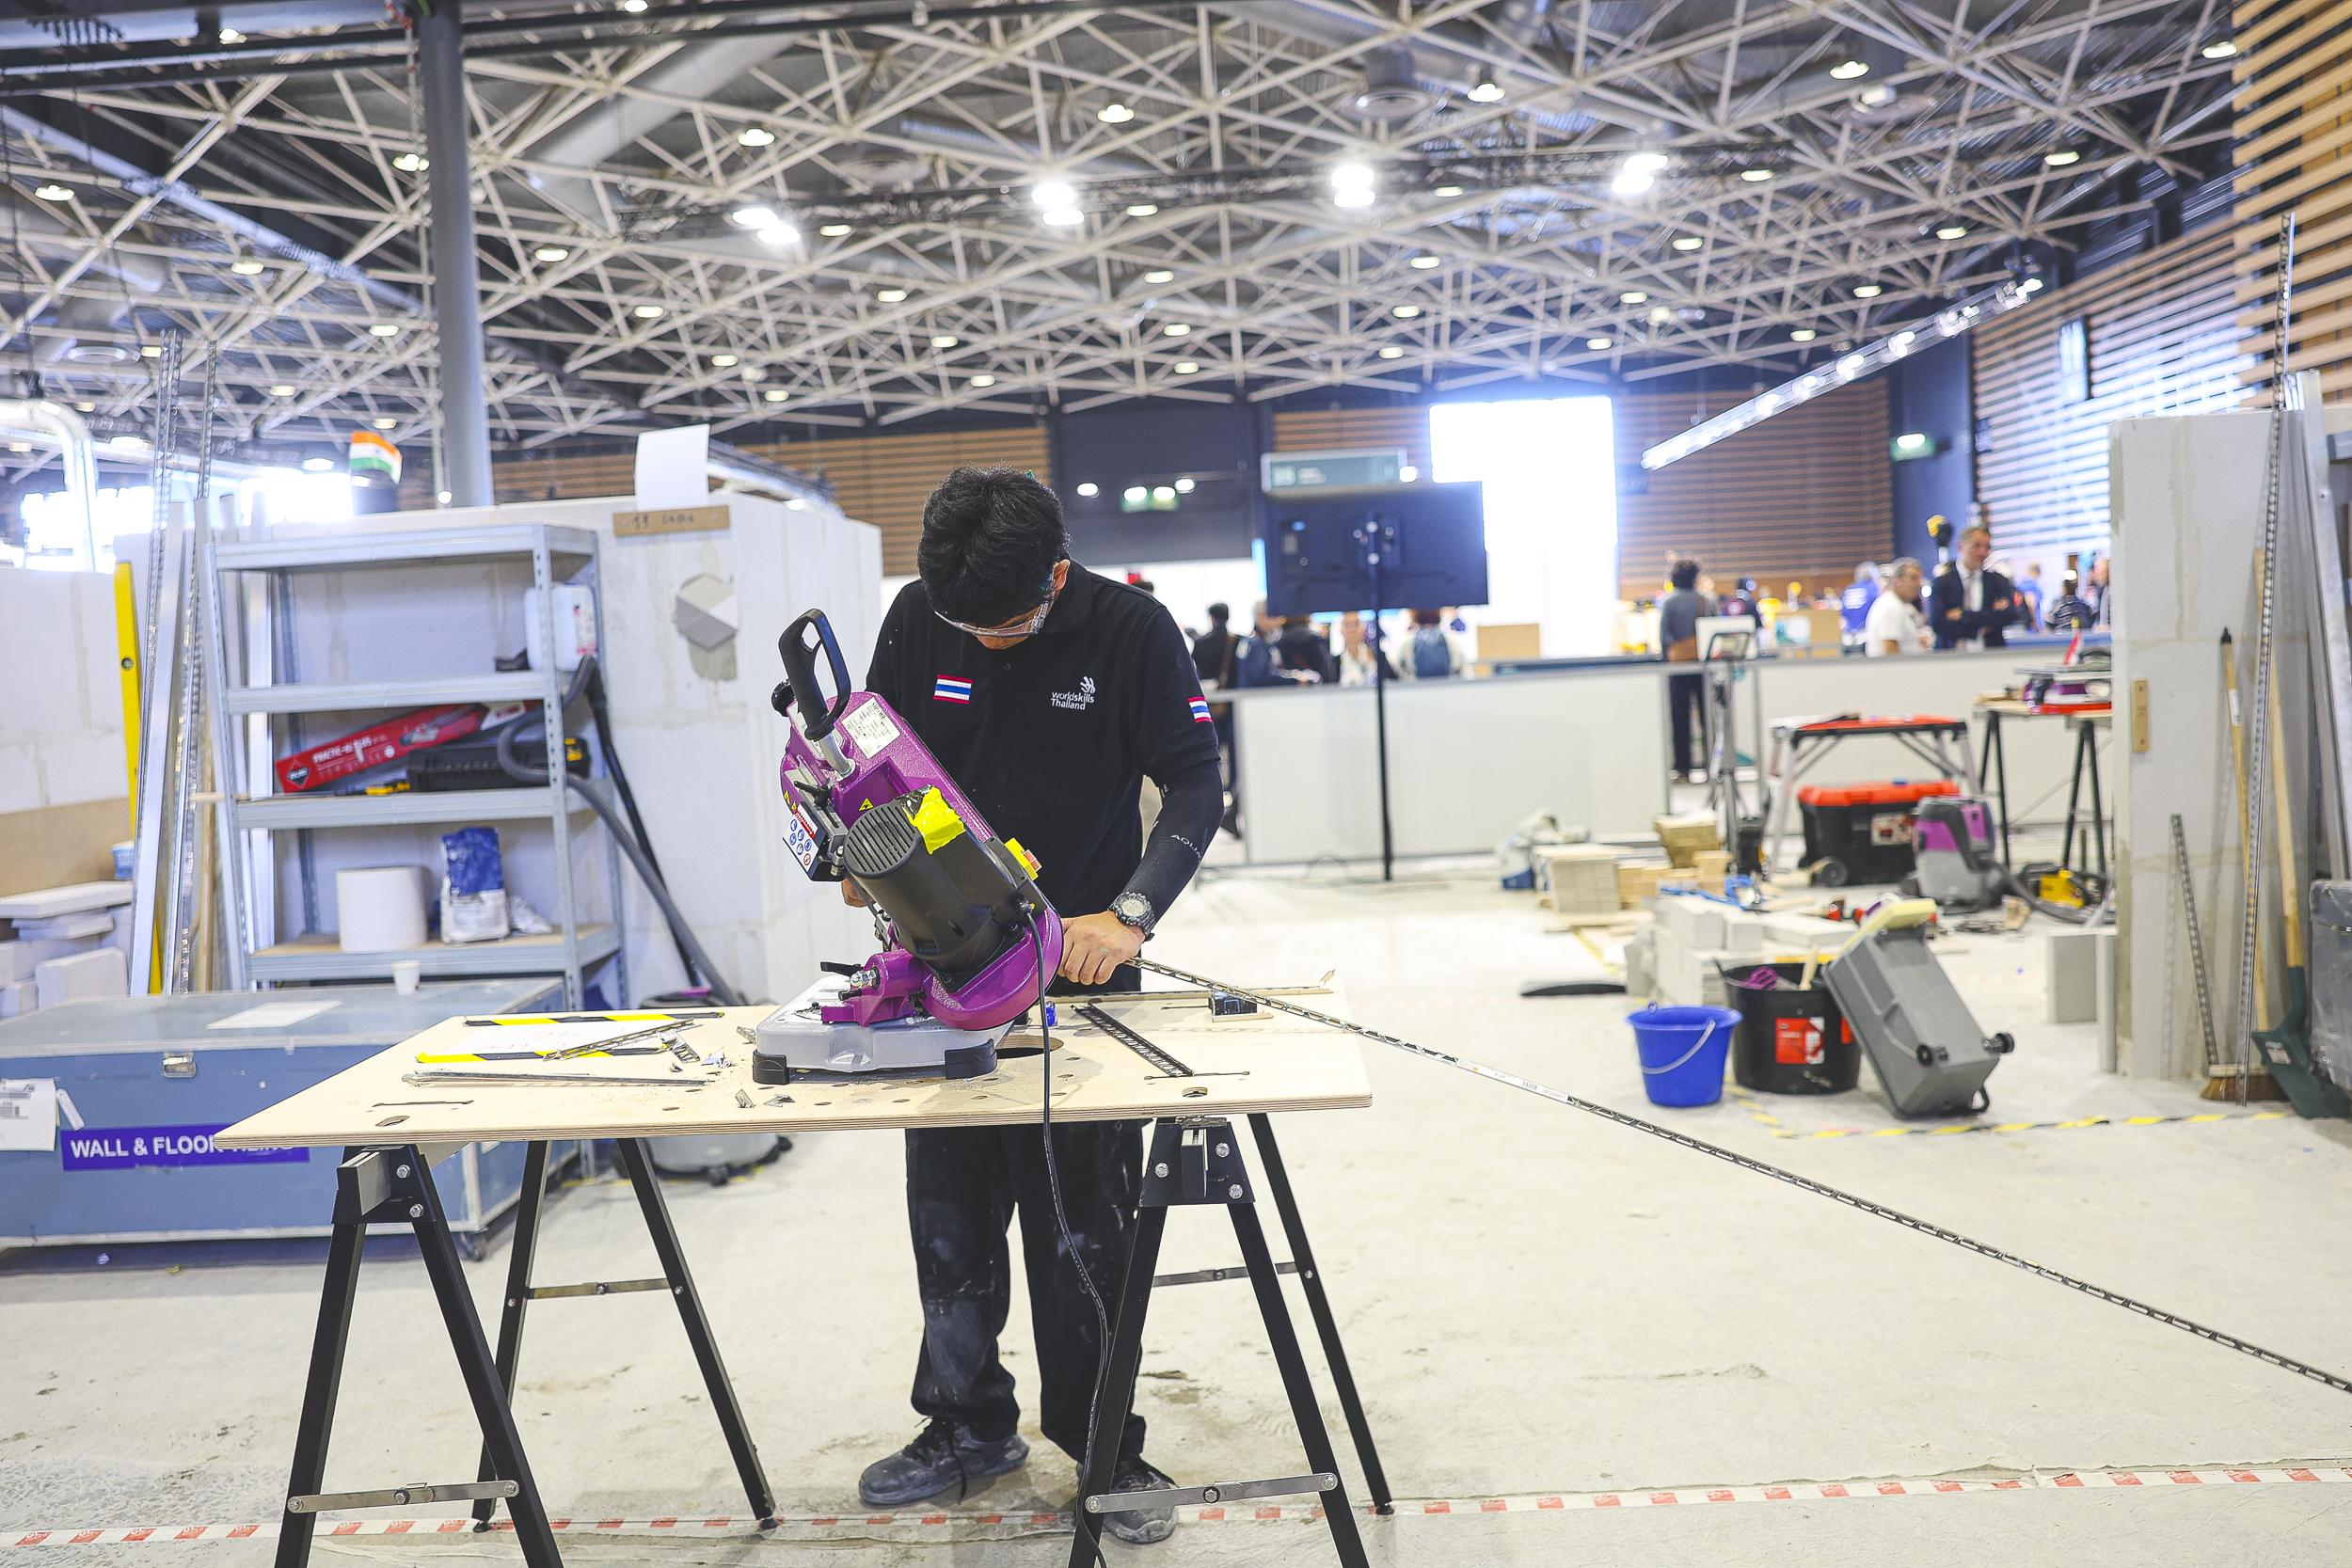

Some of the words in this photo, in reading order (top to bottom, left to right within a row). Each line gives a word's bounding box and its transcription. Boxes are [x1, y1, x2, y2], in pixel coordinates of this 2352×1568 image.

[1051, 691, 1094, 703] worldskills
[1050, 698, 1086, 710] Thailand
[70, 1138, 129, 1158] WALL
[134, 1136, 149, 1156] &
